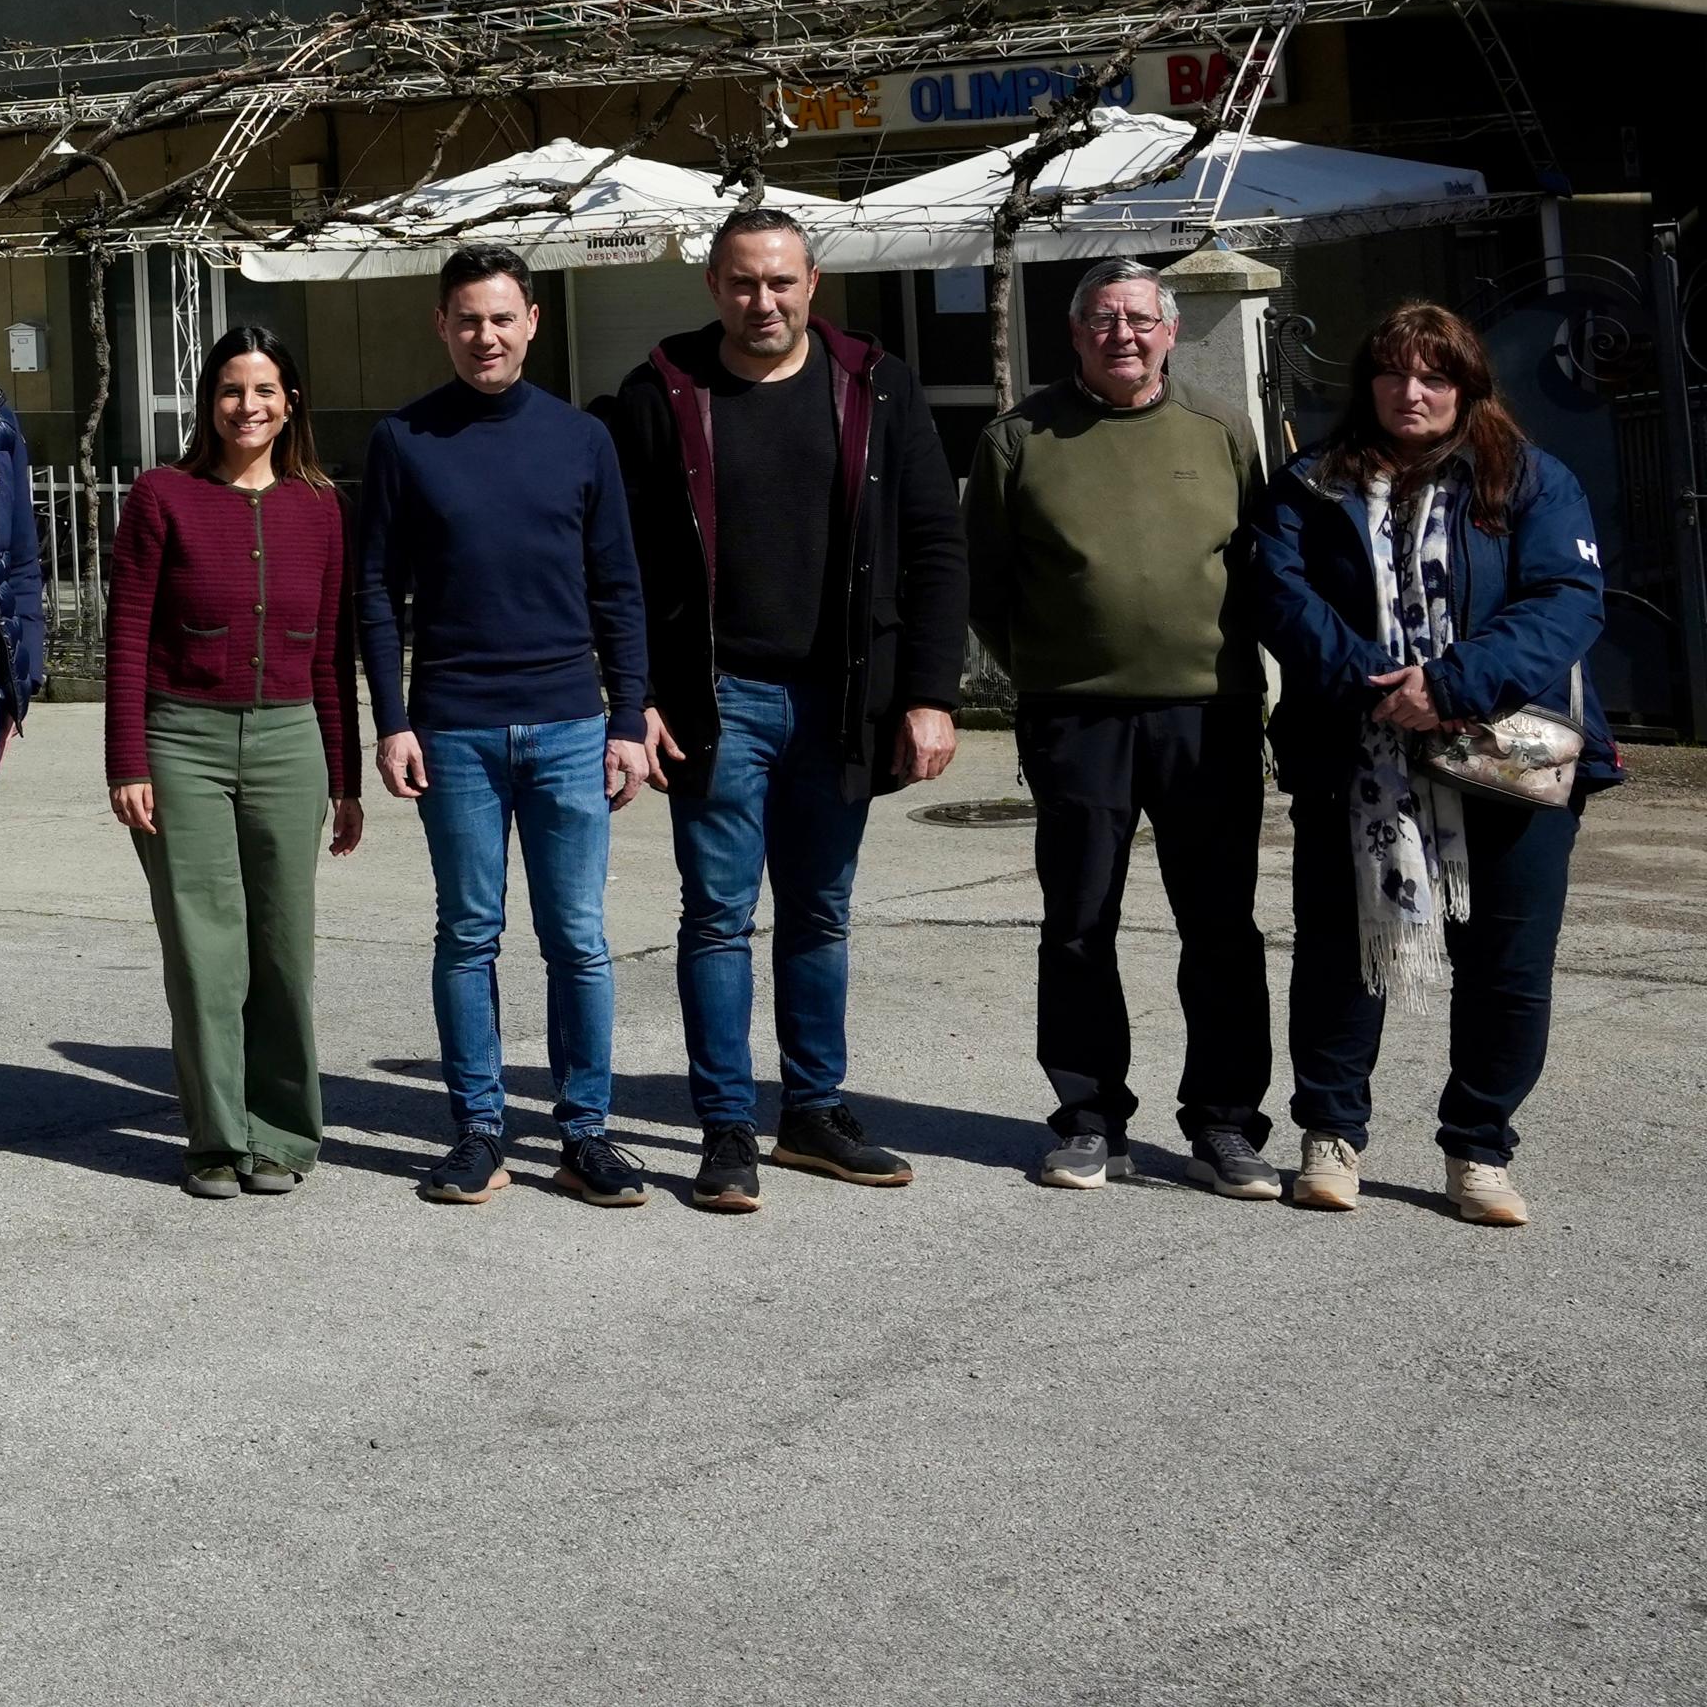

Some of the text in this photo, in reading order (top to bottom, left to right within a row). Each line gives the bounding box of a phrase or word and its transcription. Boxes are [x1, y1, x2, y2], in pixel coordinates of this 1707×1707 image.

[1170, 237, 1200, 246] DESD
[587, 252, 619, 261] DESDE
[1576, 538, 1601, 569] H
